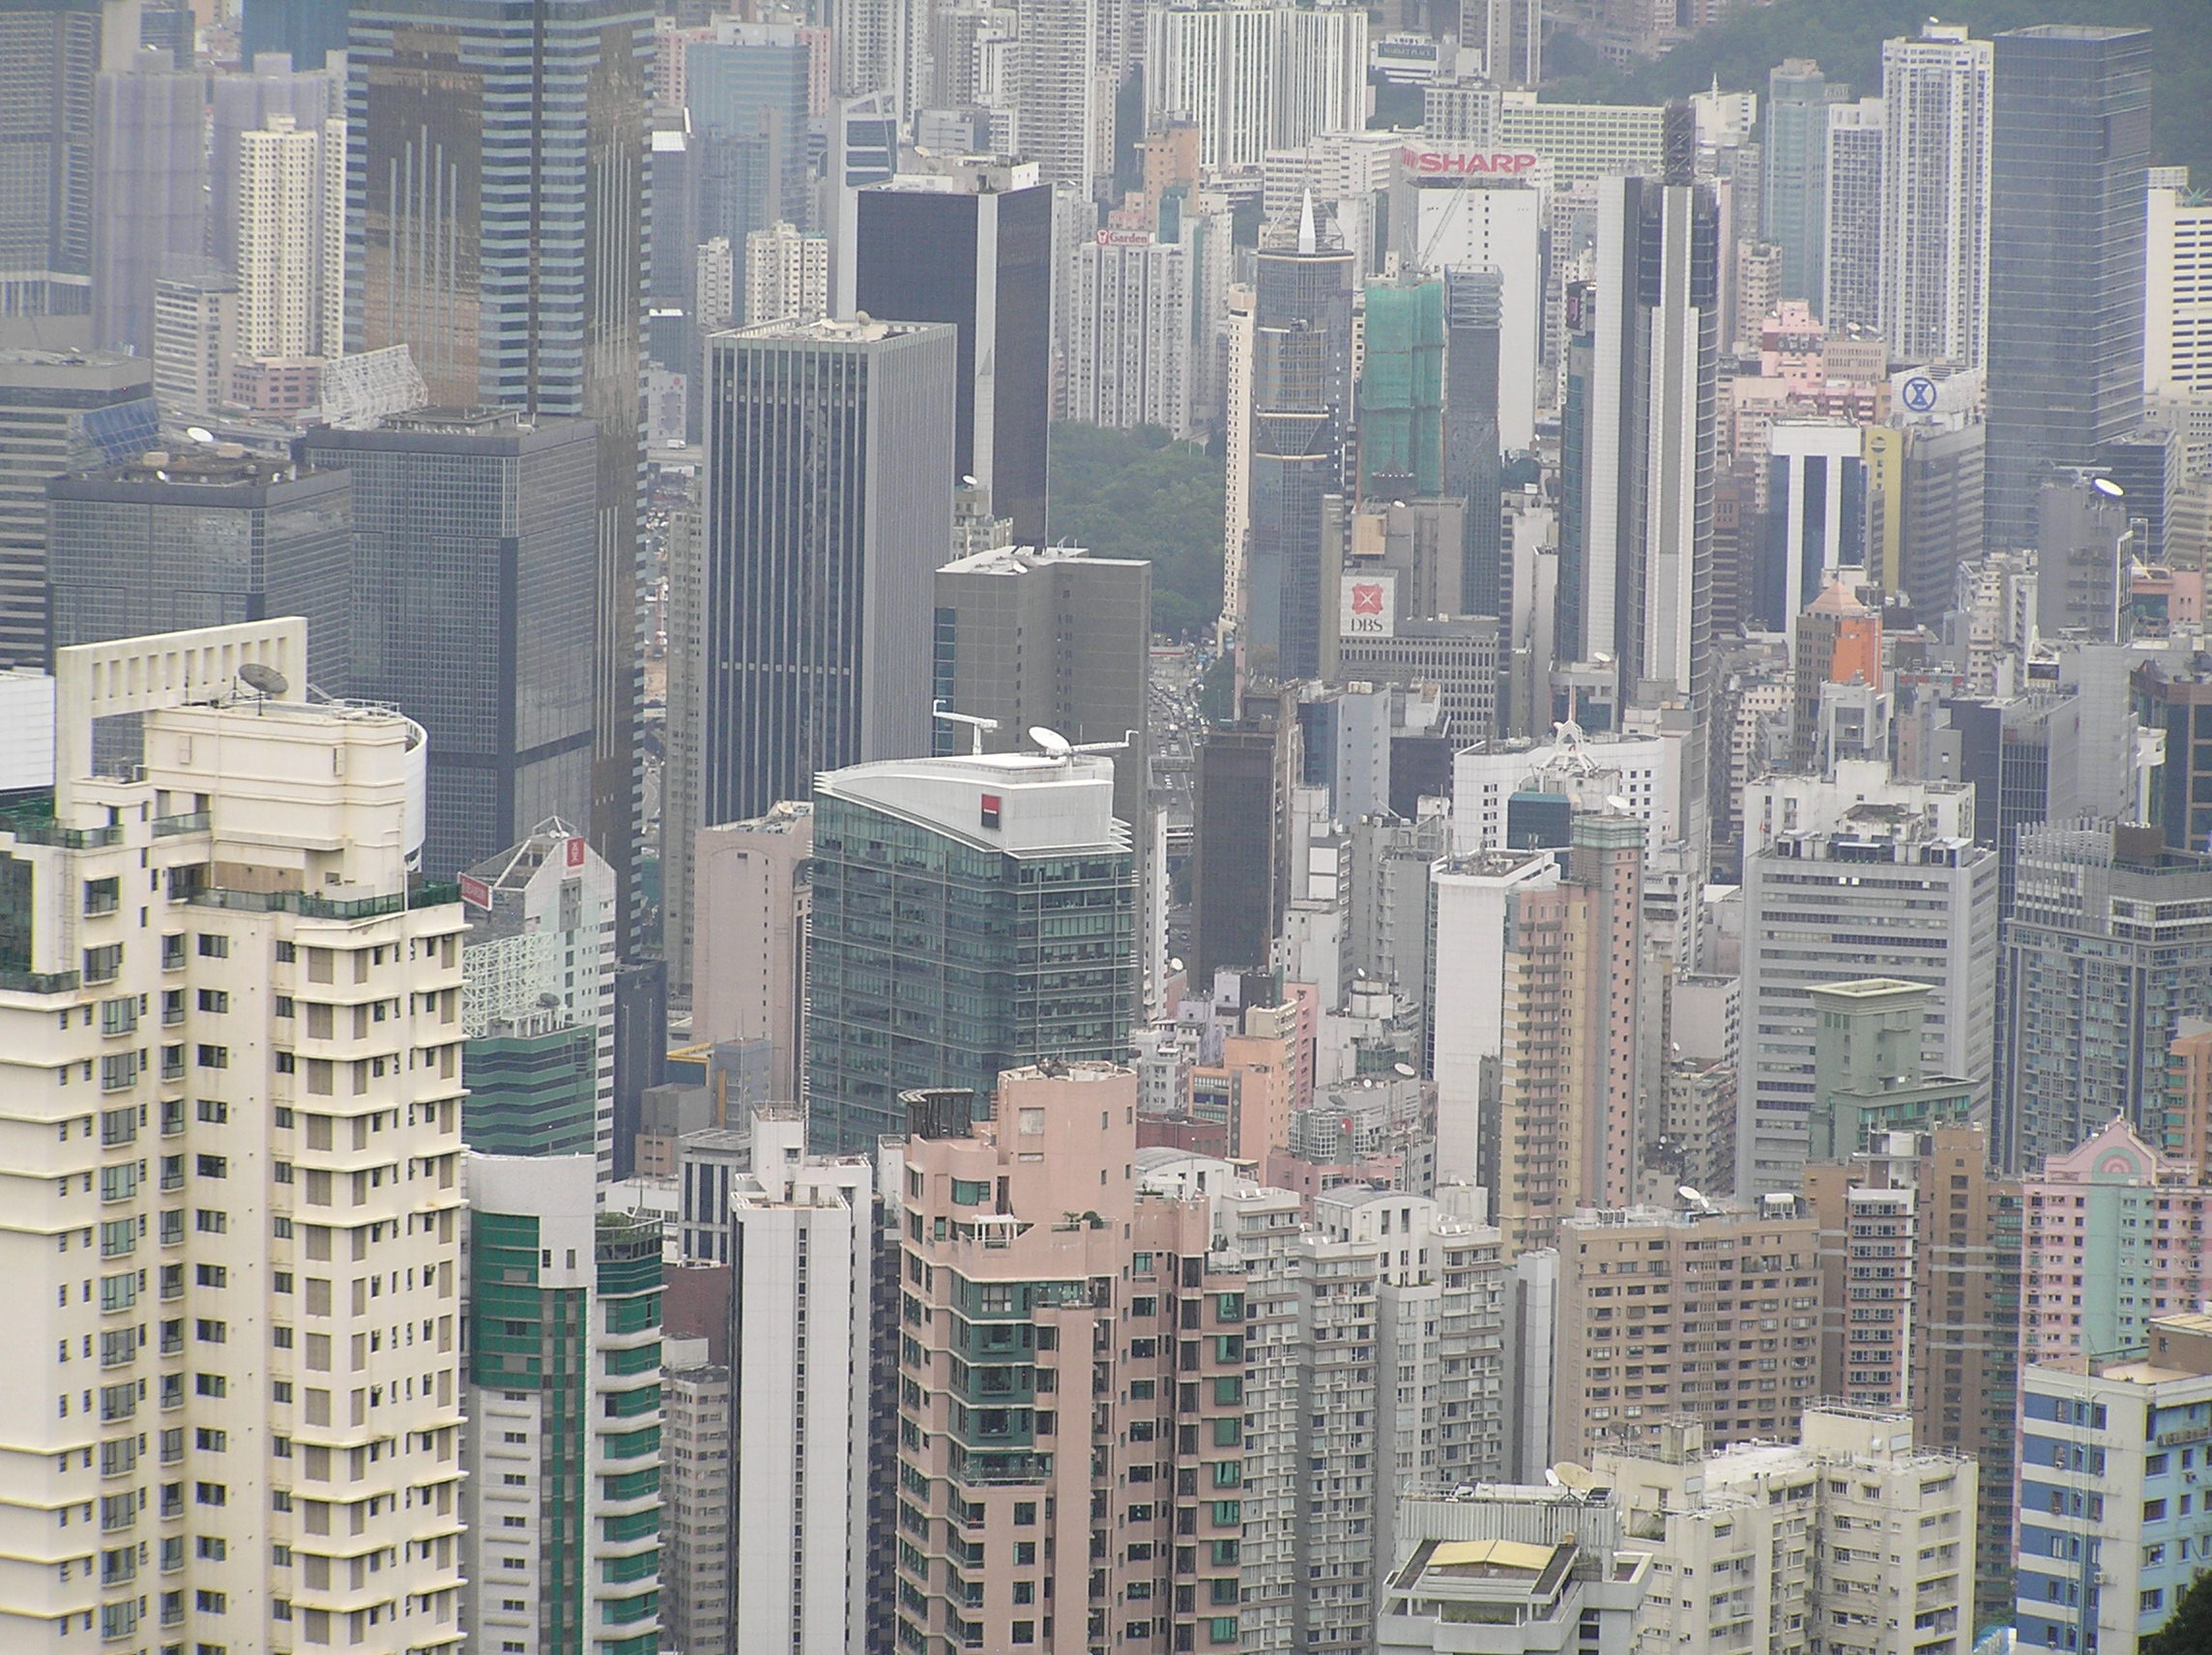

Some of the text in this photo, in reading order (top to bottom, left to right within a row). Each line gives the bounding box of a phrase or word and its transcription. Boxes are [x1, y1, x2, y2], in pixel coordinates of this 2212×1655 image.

[1418, 153, 1536, 173] SHARP
[1110, 232, 1148, 243] Garden
[1351, 618, 1383, 632] DBS
